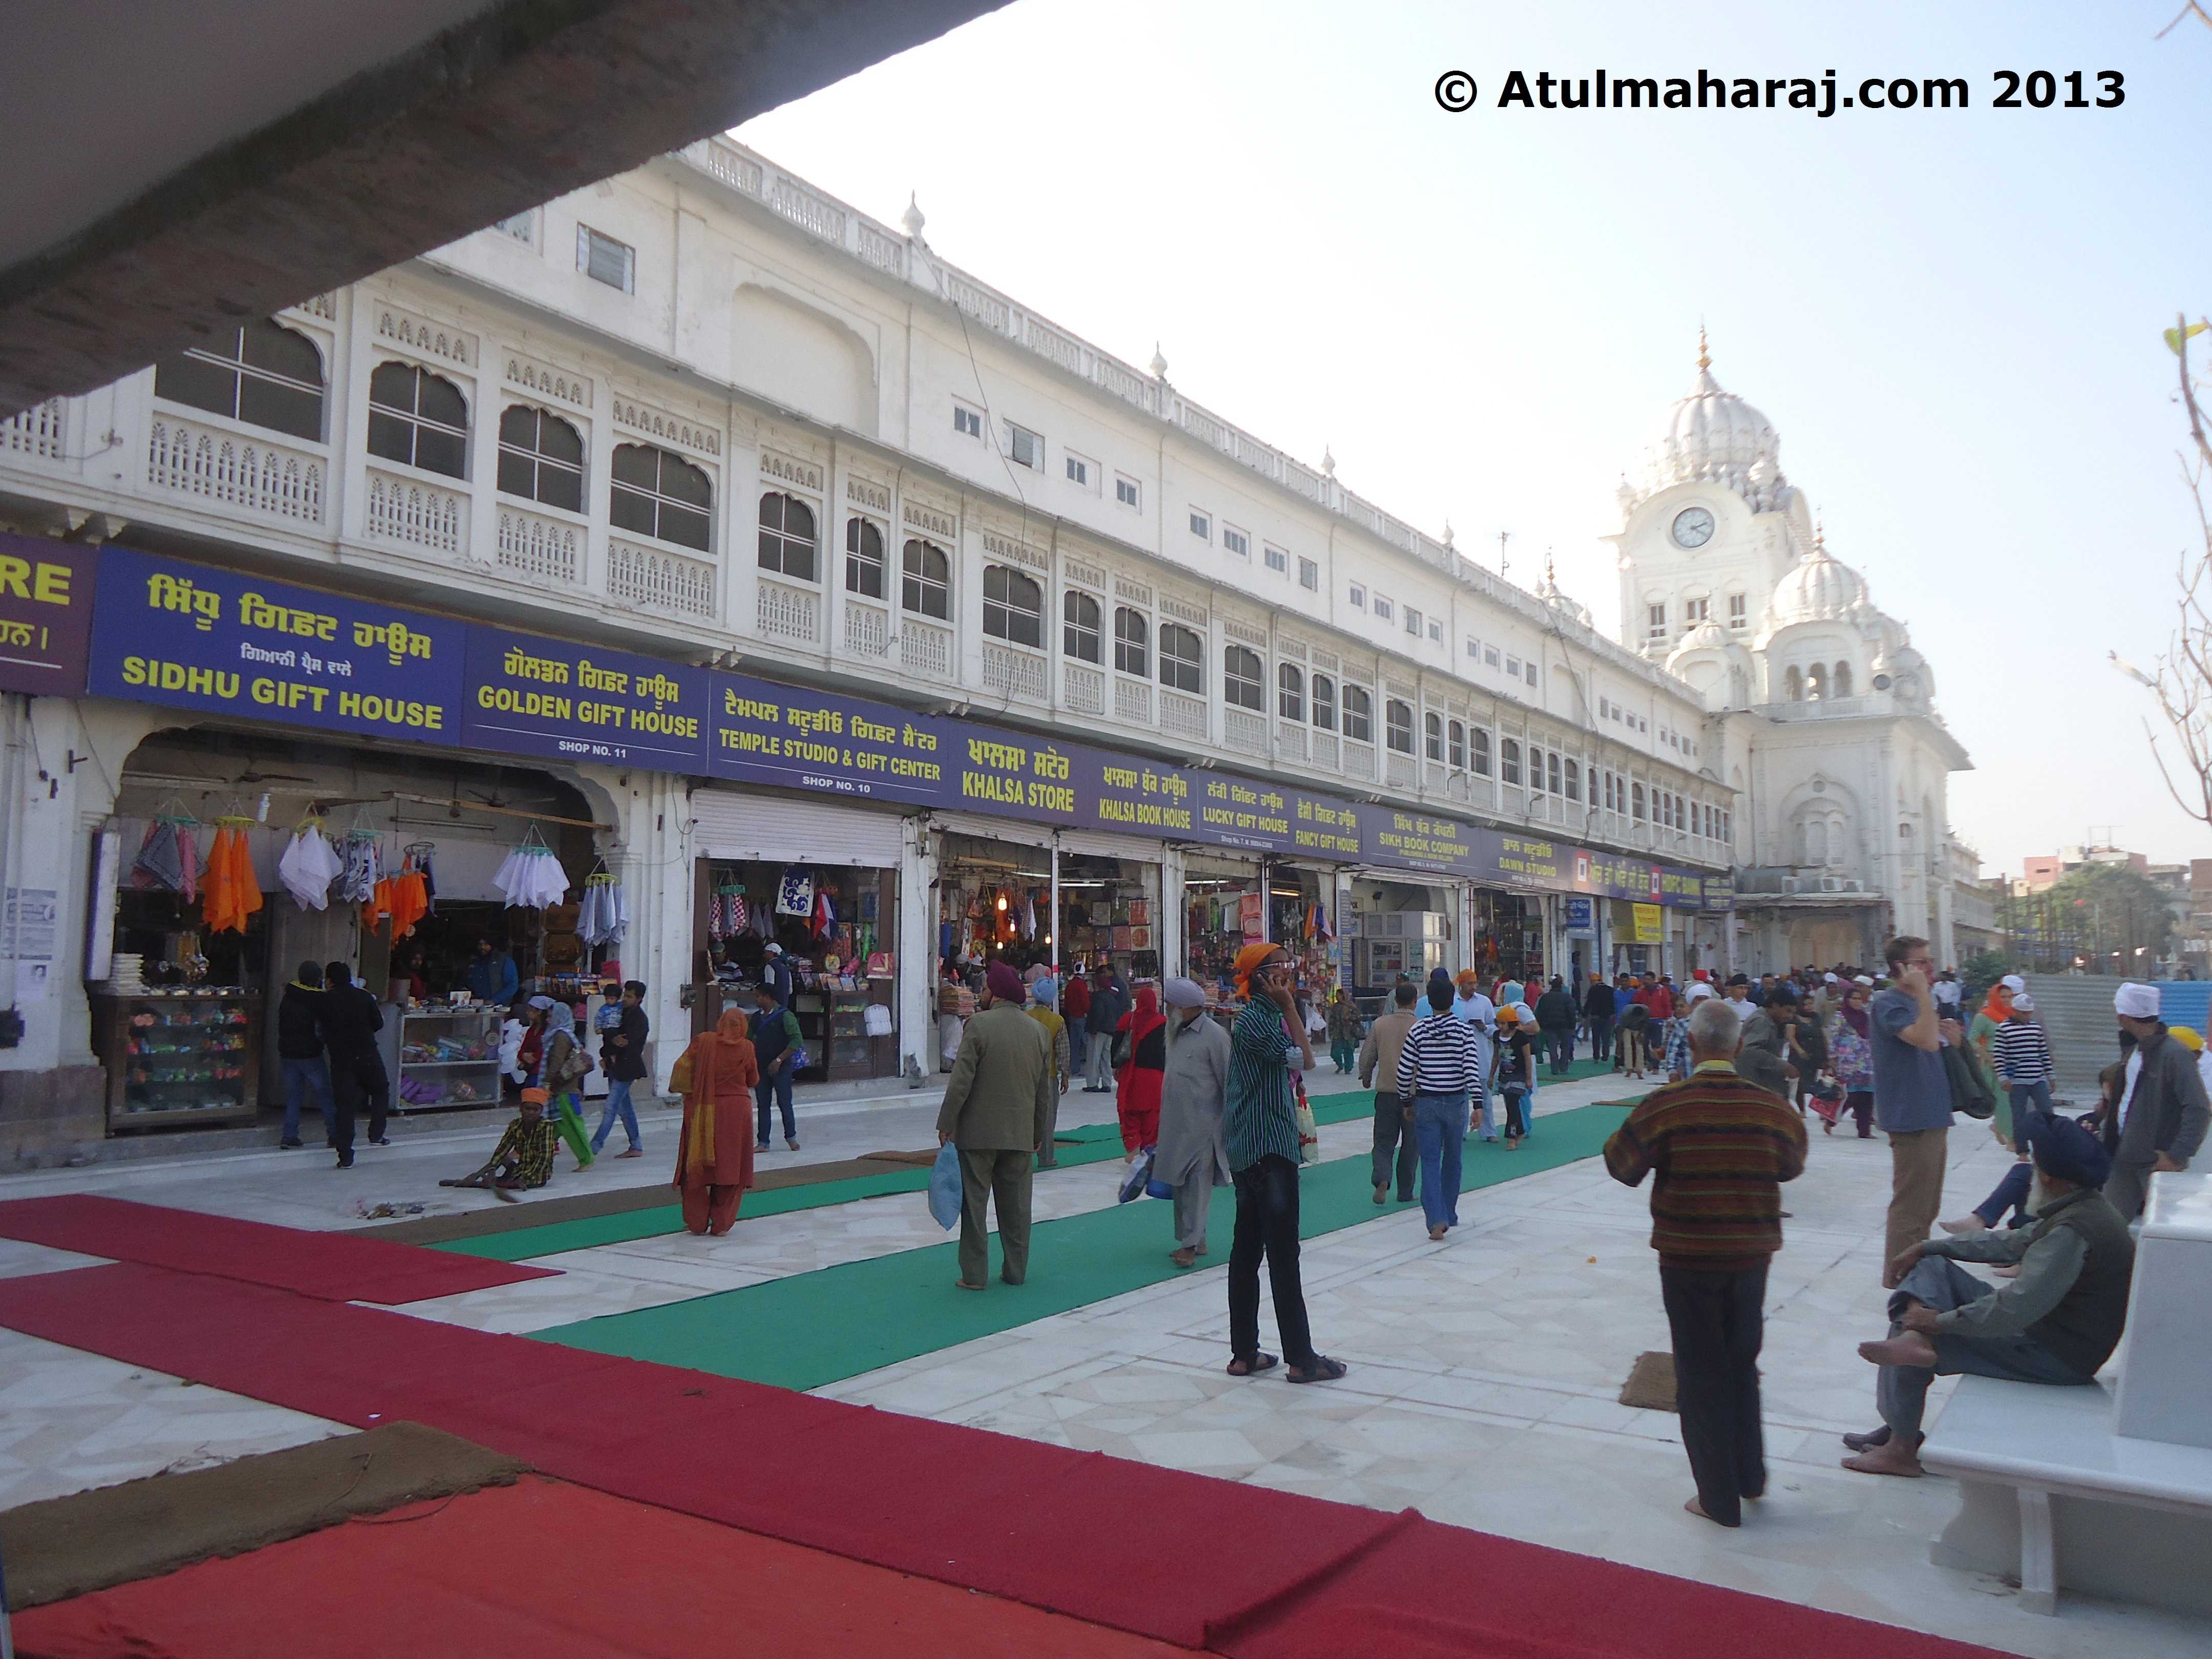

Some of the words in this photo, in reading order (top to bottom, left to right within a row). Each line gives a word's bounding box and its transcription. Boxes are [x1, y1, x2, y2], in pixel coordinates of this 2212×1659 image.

[353, 622, 432, 666] ਹਾਊਸ
[122, 656, 240, 699] SIDHU
[251, 677, 330, 713] GIFT
[339, 690, 443, 730] HOUSE
[635, 673, 679, 711] ਹਾਊਸ
[478, 685, 571, 719] GOLDEN
[578, 701, 625, 728] GIFT
[631, 710, 699, 738] HOUSE
[559, 740, 589, 754] SHOP
[592, 746, 611, 756] NO.
[614, 749, 627, 758] 11
[719, 729, 780, 755] TEMPLE
[784, 739, 838, 765] STUDIO
[842, 749, 853, 767] &
[857, 752, 888, 773] GIFT
[891, 757, 941, 781] CENTER
[802, 776, 834, 789] SHOP
[836, 781, 855, 792] NO.
[858, 783, 871, 794] 10
[963, 771, 1024, 804] KHALSA
[1028, 782, 1074, 812] STORE
[1099, 798, 1135, 823] KHALSA
[1137, 803, 1161, 825] BOOK
[1163, 807, 1190, 830] HOUSE
[1203, 806, 1235, 825] LUCKY
[1237, 814, 1256, 829] GIFT
[1259, 817, 1288, 834] HOUSE
[1296, 830, 1318, 845] FANCY
[1320, 834, 1335, 848] GIFT
[1337, 837, 1358, 853] HOUSE
[1379, 832, 1401, 847] SIKH
[1404, 837, 1429, 852] BOOK
[1431, 841, 1470, 857] COMPANY
[1499, 857, 1524, 872] DAWN
[1526, 862, 1557, 877] STUDIO
